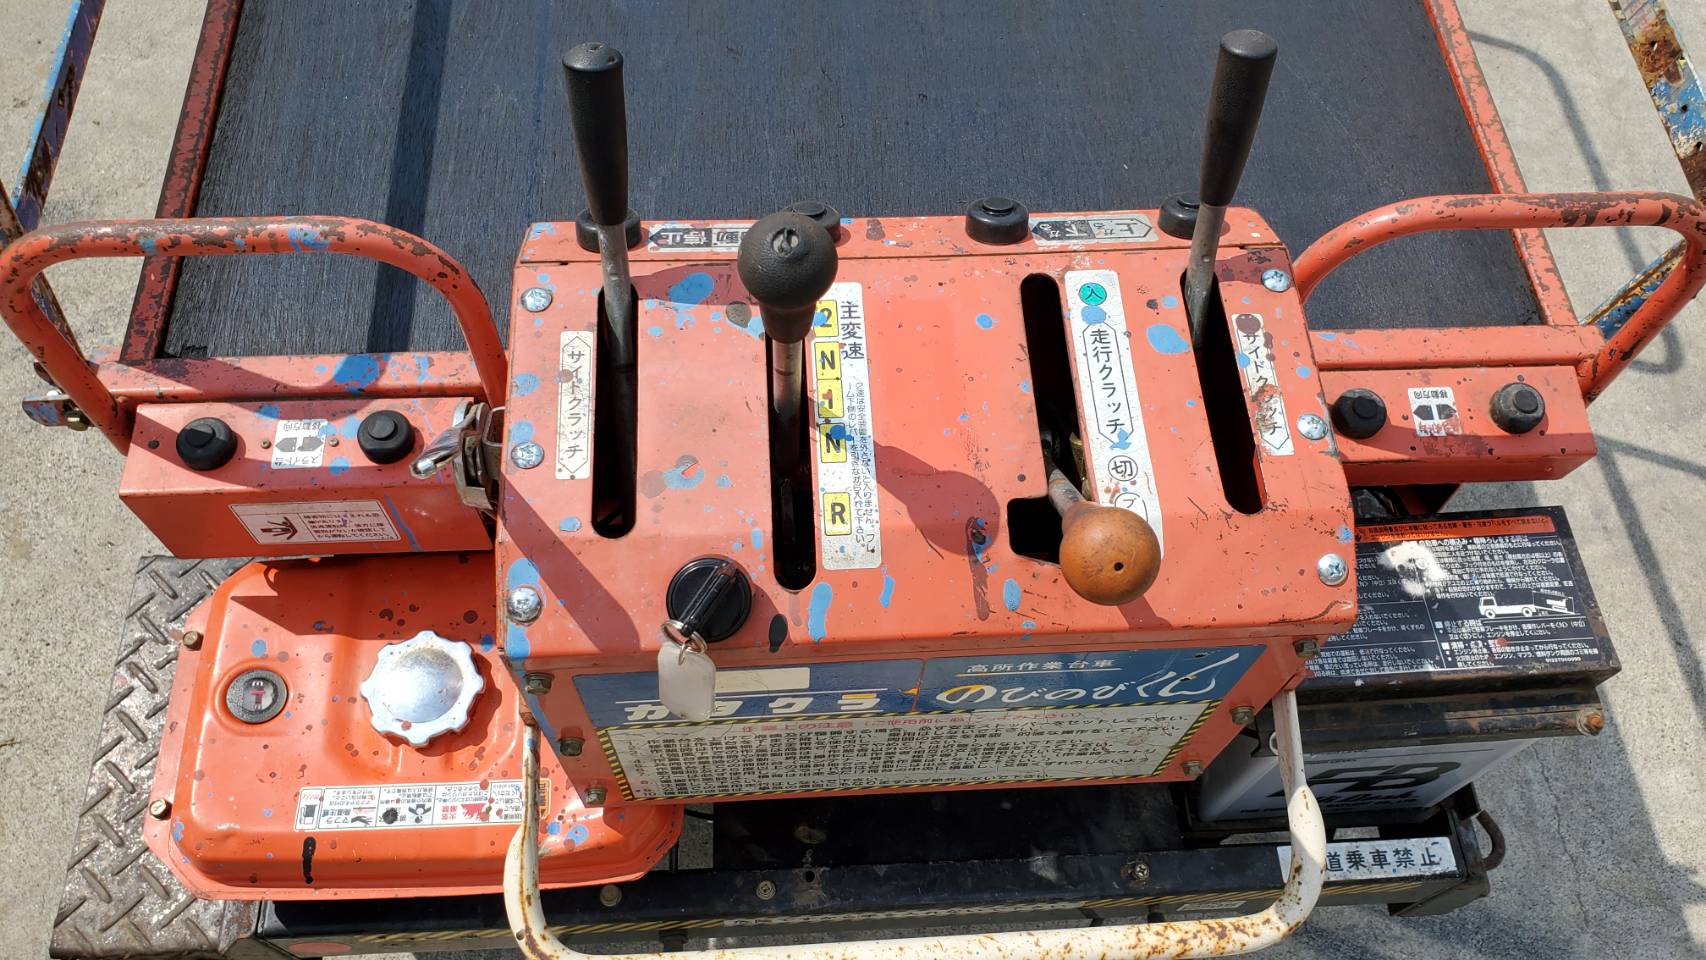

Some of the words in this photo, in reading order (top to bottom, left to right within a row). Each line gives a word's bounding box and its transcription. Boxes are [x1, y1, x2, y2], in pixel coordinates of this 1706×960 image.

[660, 231, 706, 246] 停止
[1086, 285, 1101, 301] 入
[840, 301, 865, 360] 主変速
[820, 350, 835, 370] N
[1089, 328, 1125, 434] 走行クラッチ
[826, 432, 841, 453] N
[1112, 460, 1134, 477] 切
[831, 502, 847, 525] R
[967, 658, 1116, 673] 高所作業台車
[936, 652, 1240, 704] のびのびくん
[1326, 847, 1442, 873] 道乗車禁止
